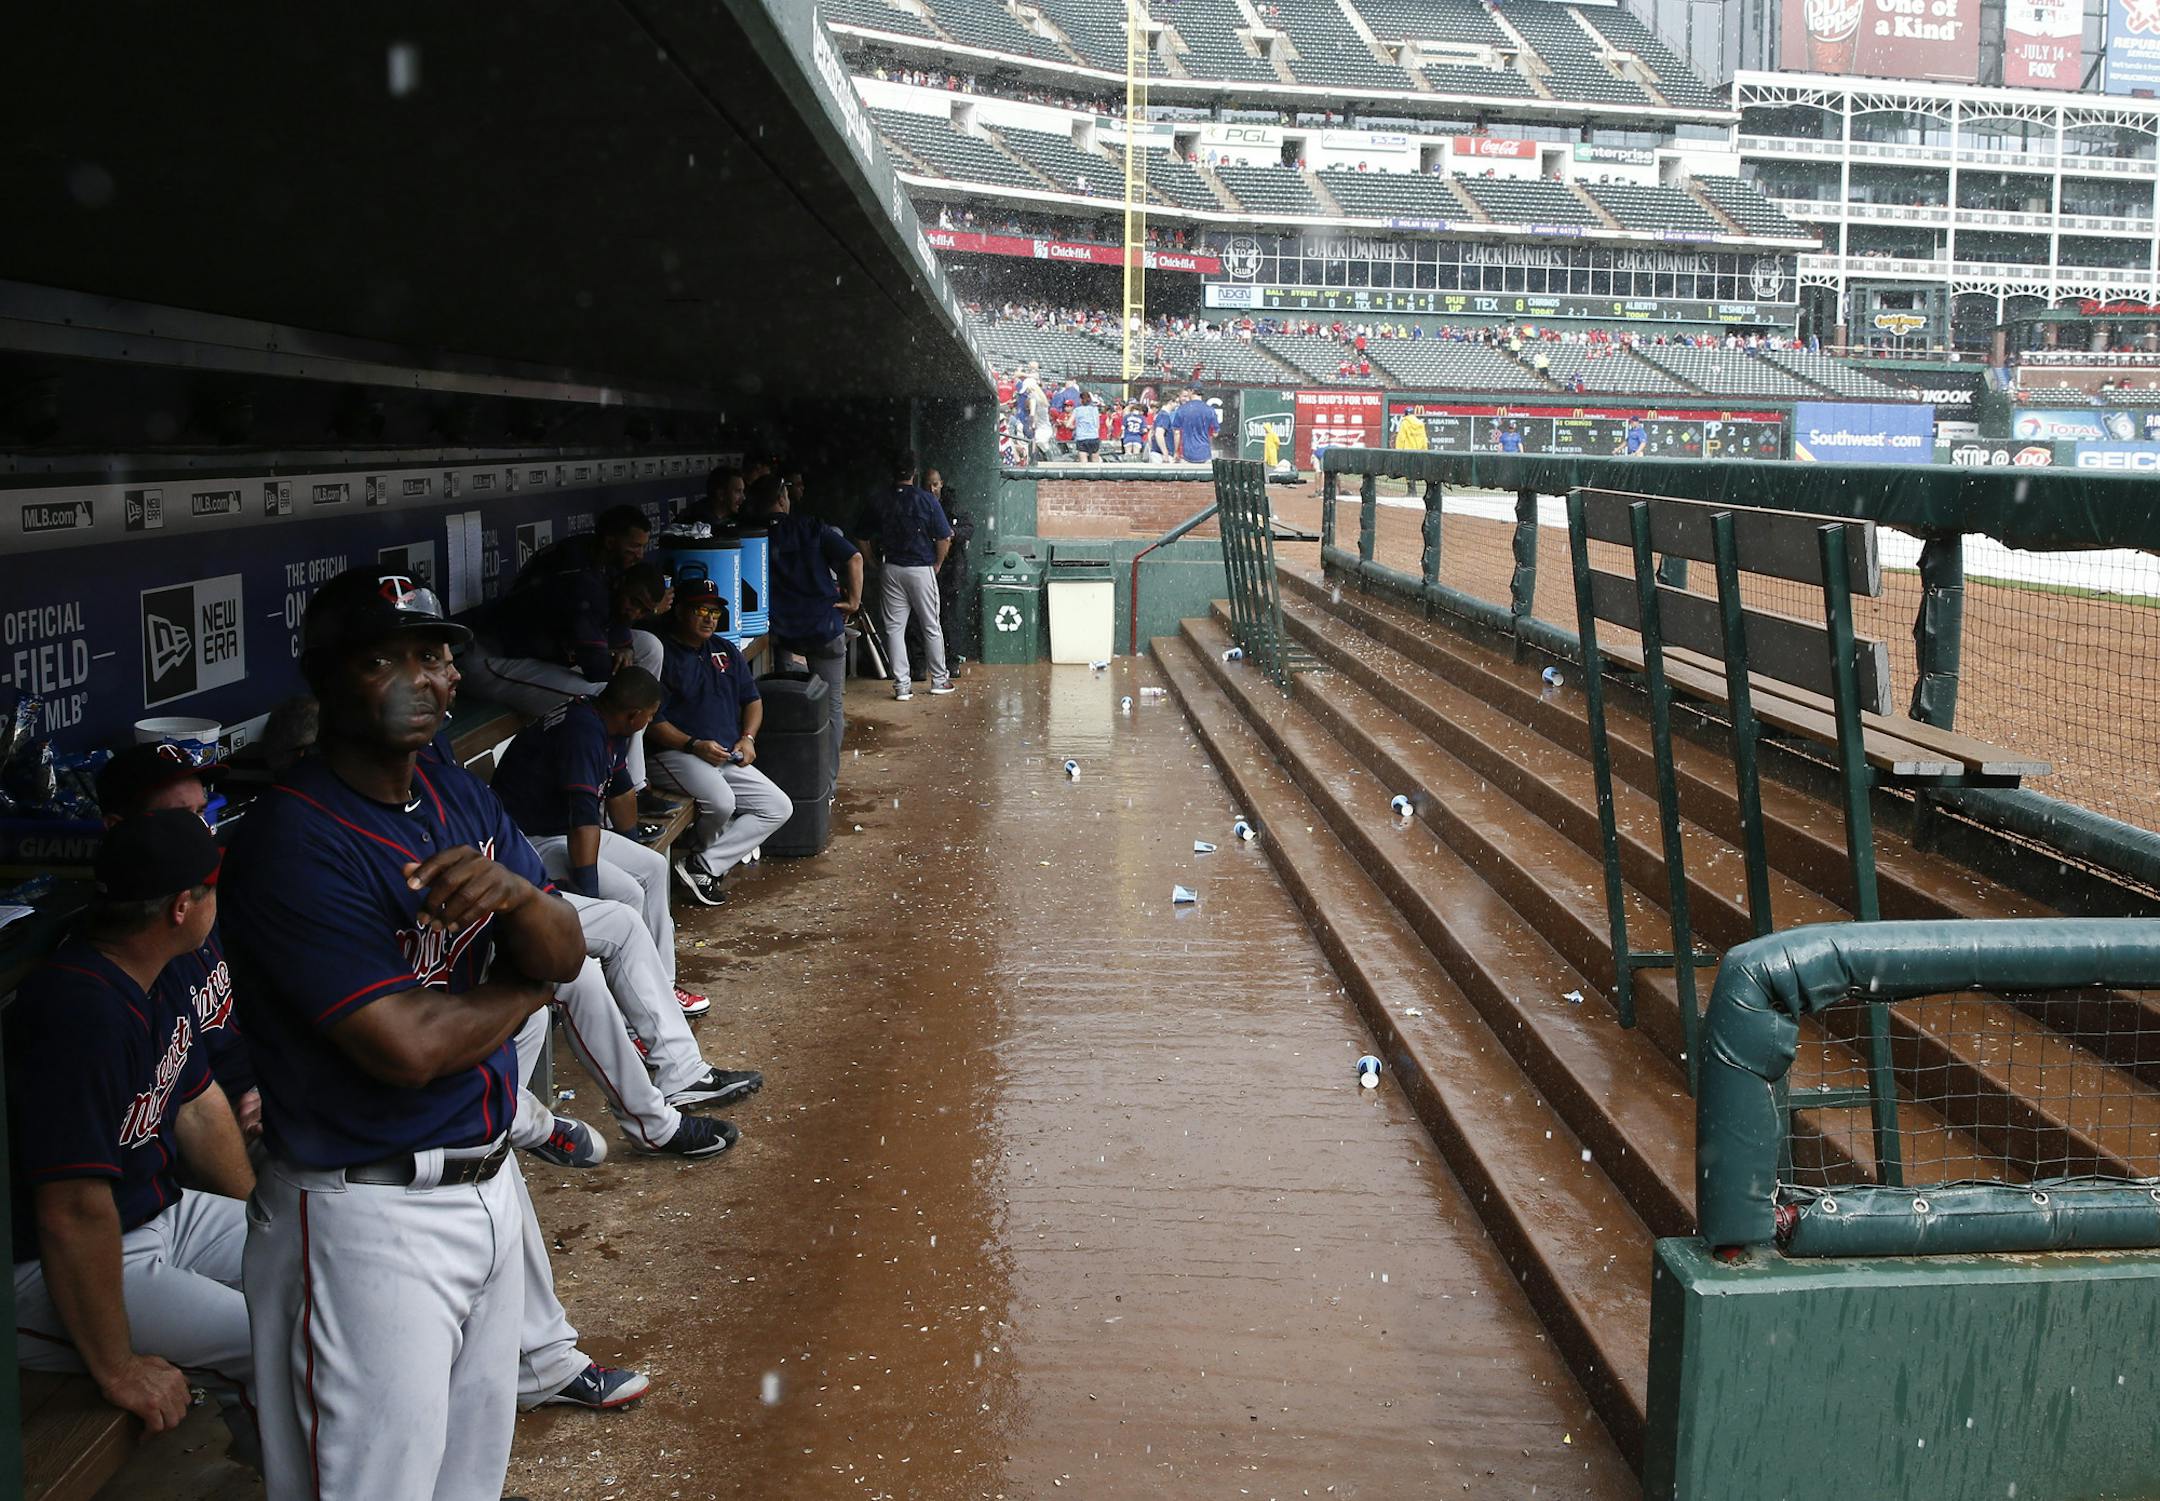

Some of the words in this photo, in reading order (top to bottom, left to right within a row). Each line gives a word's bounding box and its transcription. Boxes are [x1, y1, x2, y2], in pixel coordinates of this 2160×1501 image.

[1875, 20, 1889, 36] a
[2020, 44, 2050, 60] JULY
[2052, 46, 2065, 61] 14
[2028, 61, 2056, 78] FOX
[1225, 128, 1275, 143] PGL
[1307, 238, 1346, 259] JACK
[1266, 288, 1284, 296] BALL
[1272, 297, 1279, 307] 0
[1301, 298, 1308, 308] 0
[1328, 299, 1335, 308] 0
[1355, 301, 1370, 310] TEX
[1445, 296, 1466, 305] DUE
[1449, 304, 1462, 312] UP
[1474, 297, 1499, 311] TEX
[1298, 394, 1317, 404] THIS
[1344, 395, 1361, 405] FOR
[2048, 423, 2102, 438] TOTAL
[1952, 449, 1990, 466] STOP
[2078, 451, 2160, 469] GEIC
[193, 495, 229, 513] MLB.com
[24, 506, 76, 529] MLB.com
[285, 562, 306, 588] THE
[202, 598, 236, 631] NEW
[4, 600, 86, 646] OFFICIAL
[203, 630, 239, 666] ERA
